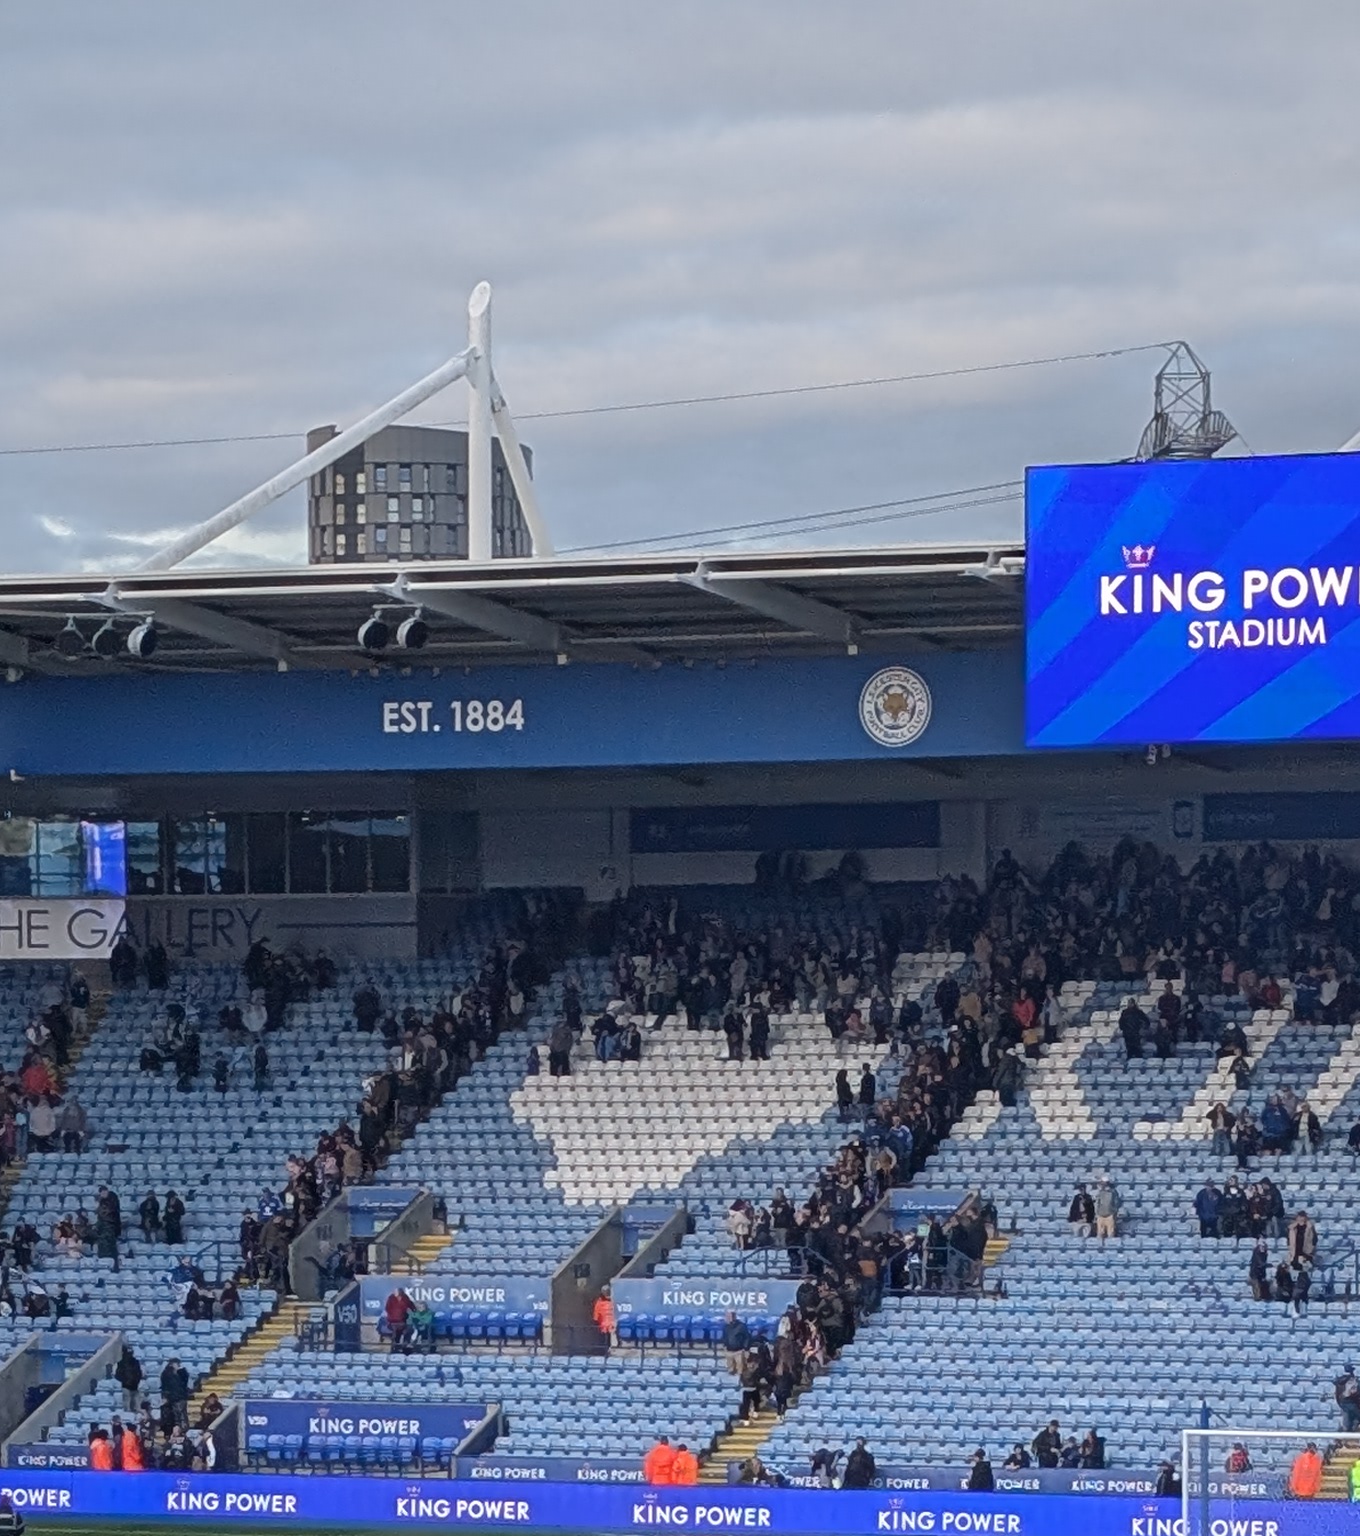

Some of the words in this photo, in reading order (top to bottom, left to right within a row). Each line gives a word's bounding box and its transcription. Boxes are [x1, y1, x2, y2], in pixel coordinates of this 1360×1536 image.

[1100, 571, 1226, 615] KING
[1187, 617, 1327, 650] STADIUM
[383, 701, 441, 733] EST.
[450, 698, 525, 732] 1884
[405, 1288, 445, 1302] KING
[450, 1288, 506, 1303] POWER
[663, 1291, 705, 1305] KING
[710, 1292, 768, 1307] POWER
[309, 1418, 355, 1435] KING
[359, 1419, 420, 1436] POWER
[49, 1456, 88, 1467] POWER
[504, 1467, 546, 1479] POWER
[611, 1469, 644, 1481] POWE
[886, 1478, 930, 1489] POWER
[1108, 1481, 1152, 1493] POWER
[0, 1488, 71, 1508] POWER
[167, 1491, 219, 1512] KING
[225, 1493, 297, 1513] POWER
[396, 1498, 451, 1518] KING
[456, 1499, 530, 1520] POWER
[632, 1504, 689, 1524] KING
[695, 1505, 771, 1527] POWER
[878, 1511, 936, 1531] KING
[942, 1512, 1021, 1533] POWER
[1132, 1518, 1191, 1536] KING
